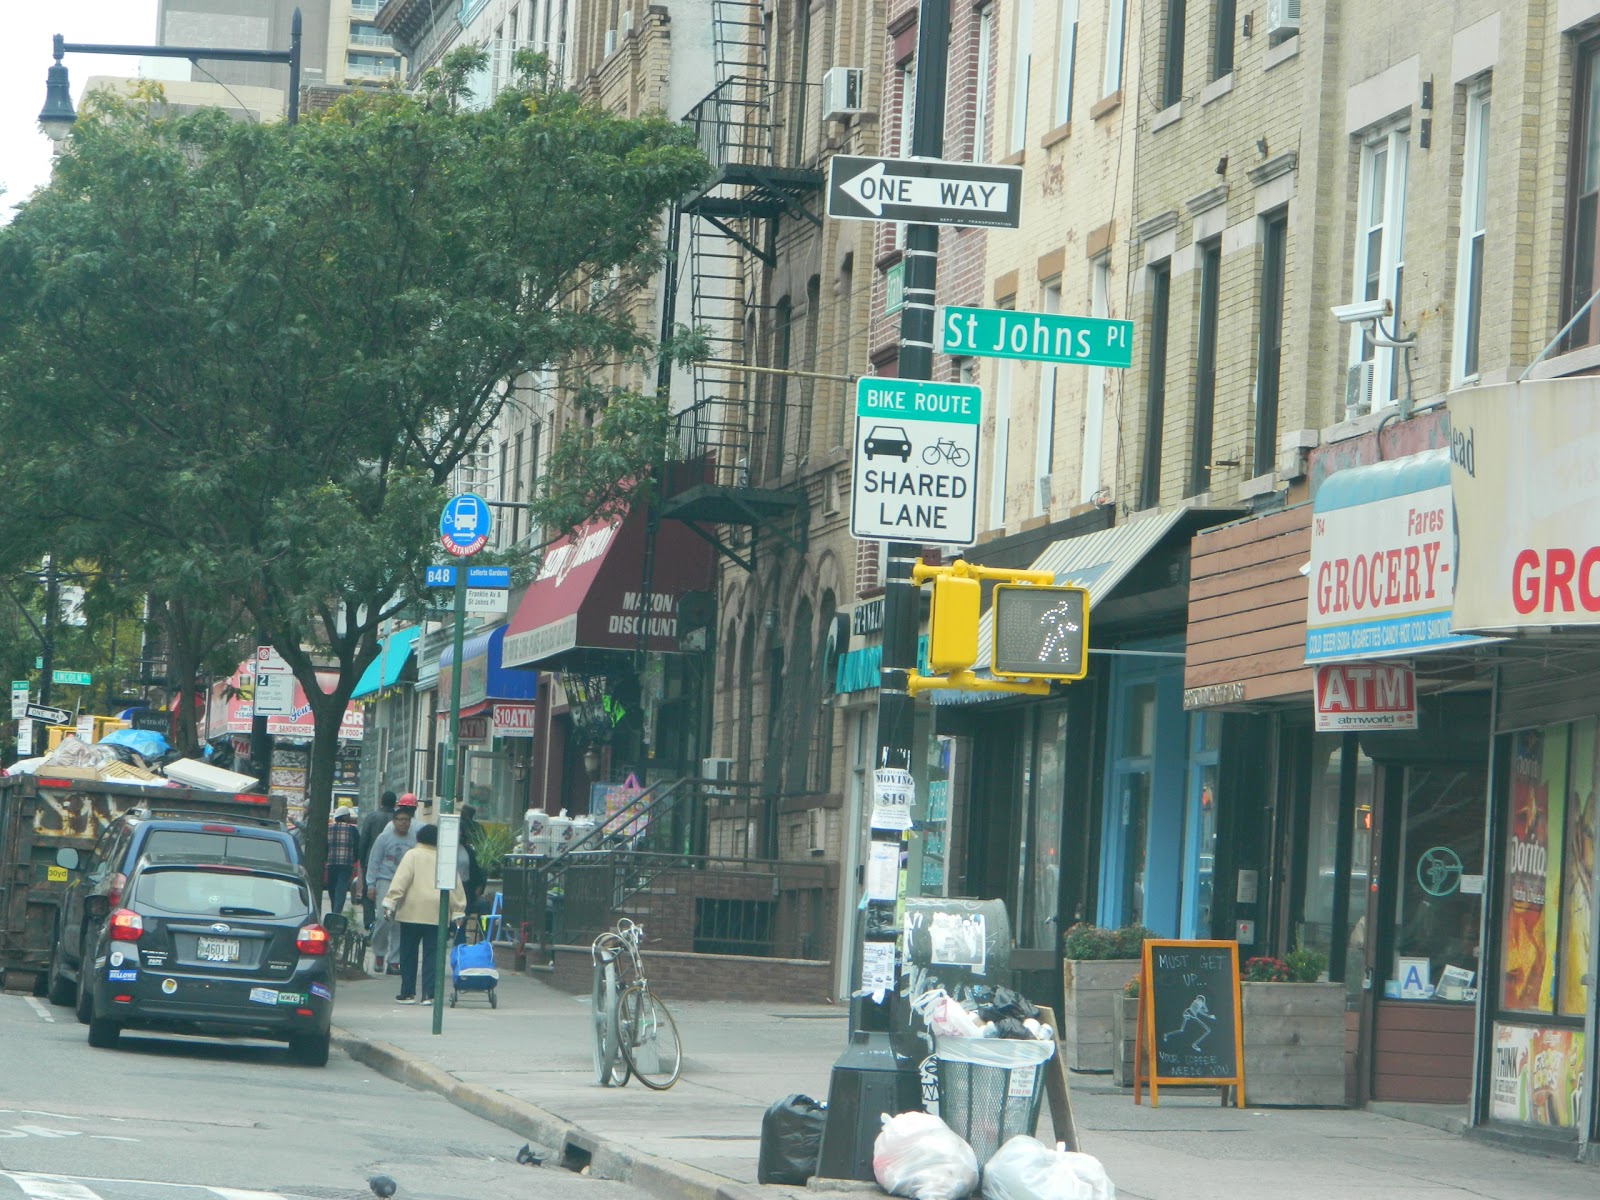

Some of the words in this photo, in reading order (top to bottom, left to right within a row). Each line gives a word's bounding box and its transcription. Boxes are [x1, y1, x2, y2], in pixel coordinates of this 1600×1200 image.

[860, 177, 913, 202] ONE
[940, 182, 997, 208] WAY
[946, 313, 978, 349] St
[993, 318, 1091, 358] Johns
[1107, 326, 1125, 348] Pl
[867, 390, 906, 410] BIKE
[915, 393, 972, 414] ROUTE
[864, 470, 967, 498] SHARED
[880, 502, 947, 529] LANE
[1408, 508, 1445, 537] Fares
[443, 535, 453, 548] NO
[452, 537, 485, 555] STANDING
[428, 569, 450, 583] B48
[54, 671, 81, 682] LINCOLN
[259, 675, 266, 686] 2
[1320, 666, 1408, 710] ATM
[51, 713, 65, 721] WAY
[1338, 715, 1395, 725] atmworld
[279, 725, 312, 734] SANDWICHES
[346, 728, 359, 737] FOOD
[876, 774, 913, 786] MOVING
[882, 793, 906, 806] $19
[48, 870, 67, 878] 30yd
[1159, 954, 1189, 969] MUST
[1200, 954, 1227, 969] GET
[1403, 965, 1423, 990] A
